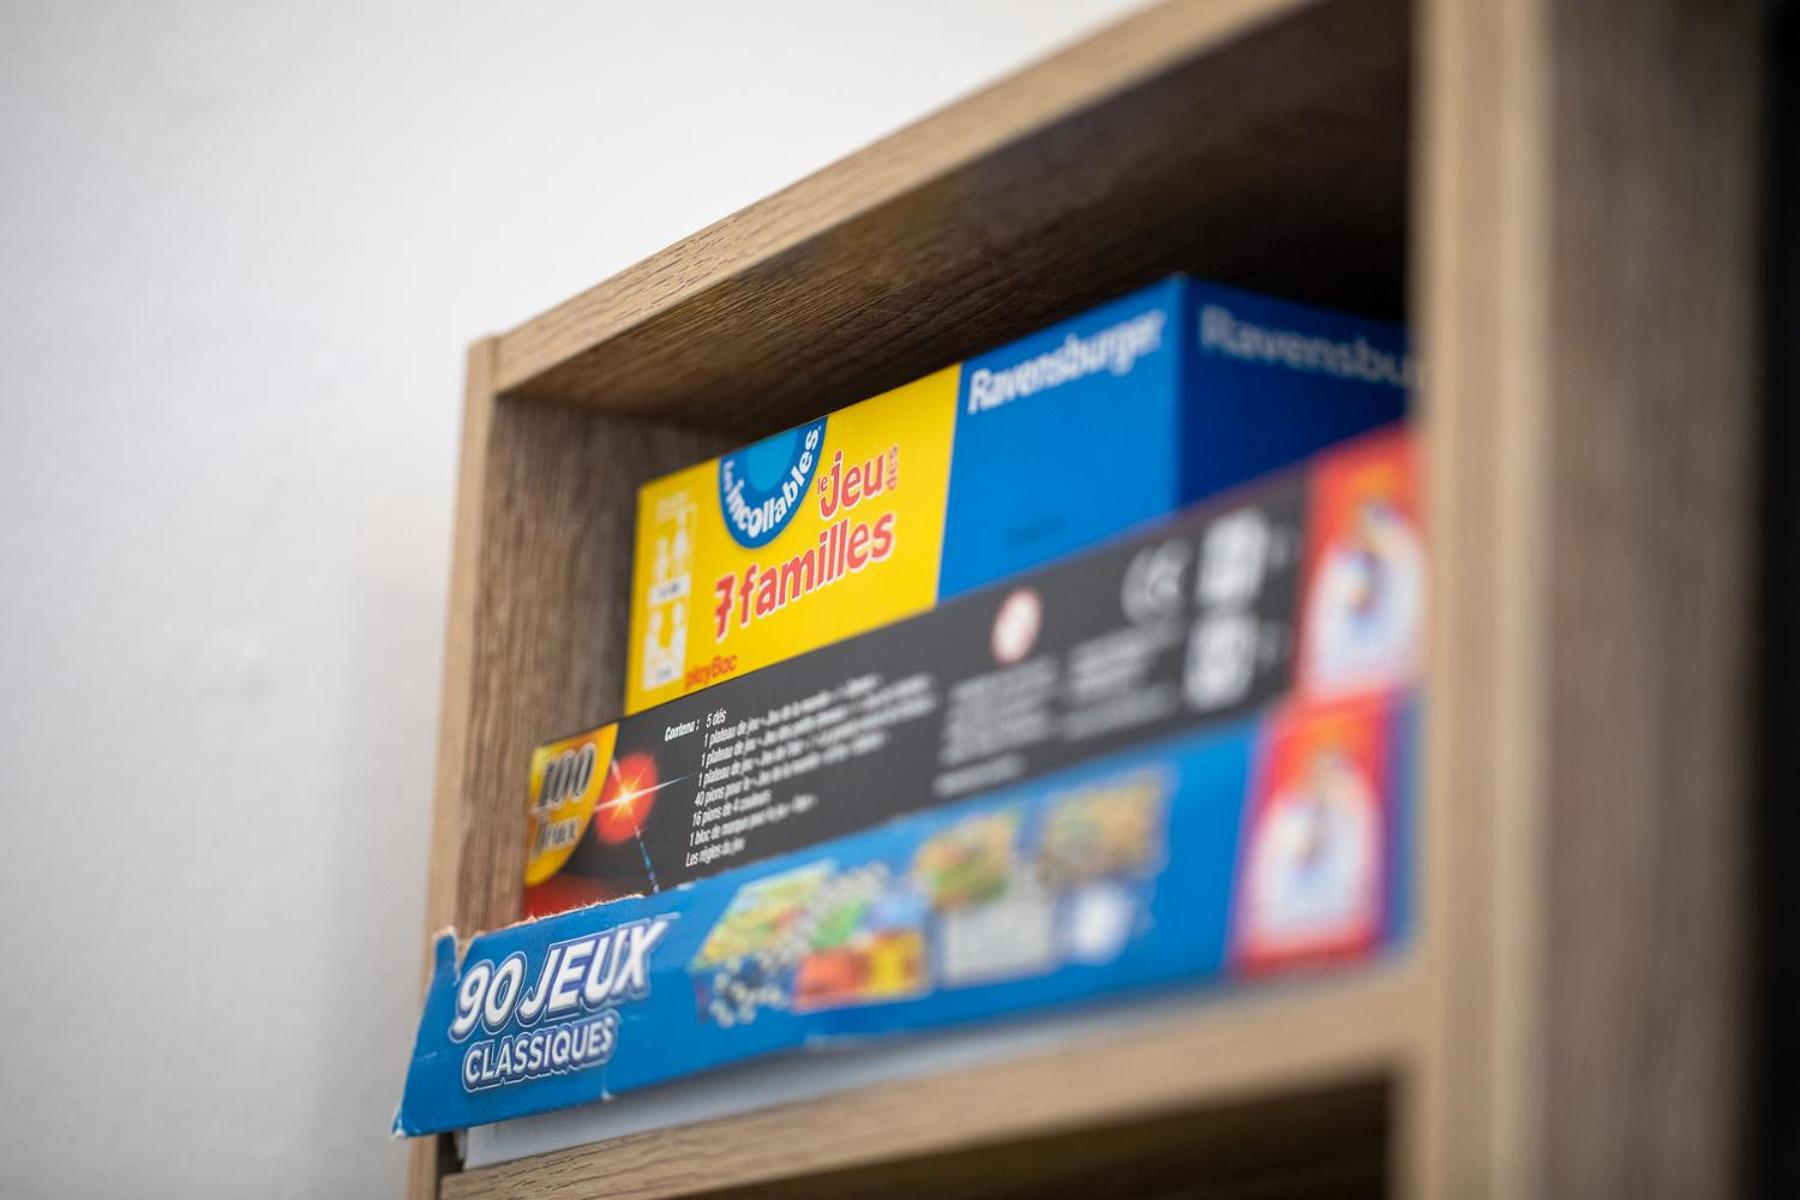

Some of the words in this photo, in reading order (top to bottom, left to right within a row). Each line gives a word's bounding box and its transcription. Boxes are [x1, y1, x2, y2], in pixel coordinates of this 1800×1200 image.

[968, 308, 1167, 415] Ravensburger
[817, 474, 829, 496] le
[819, 450, 885, 519] jeu
[714, 571, 736, 643] 7
[739, 511, 897, 628] familles
[451, 954, 526, 1040] 90
[516, 917, 670, 1015] JEUX
[463, 1012, 617, 1085] CLASSIQUES
